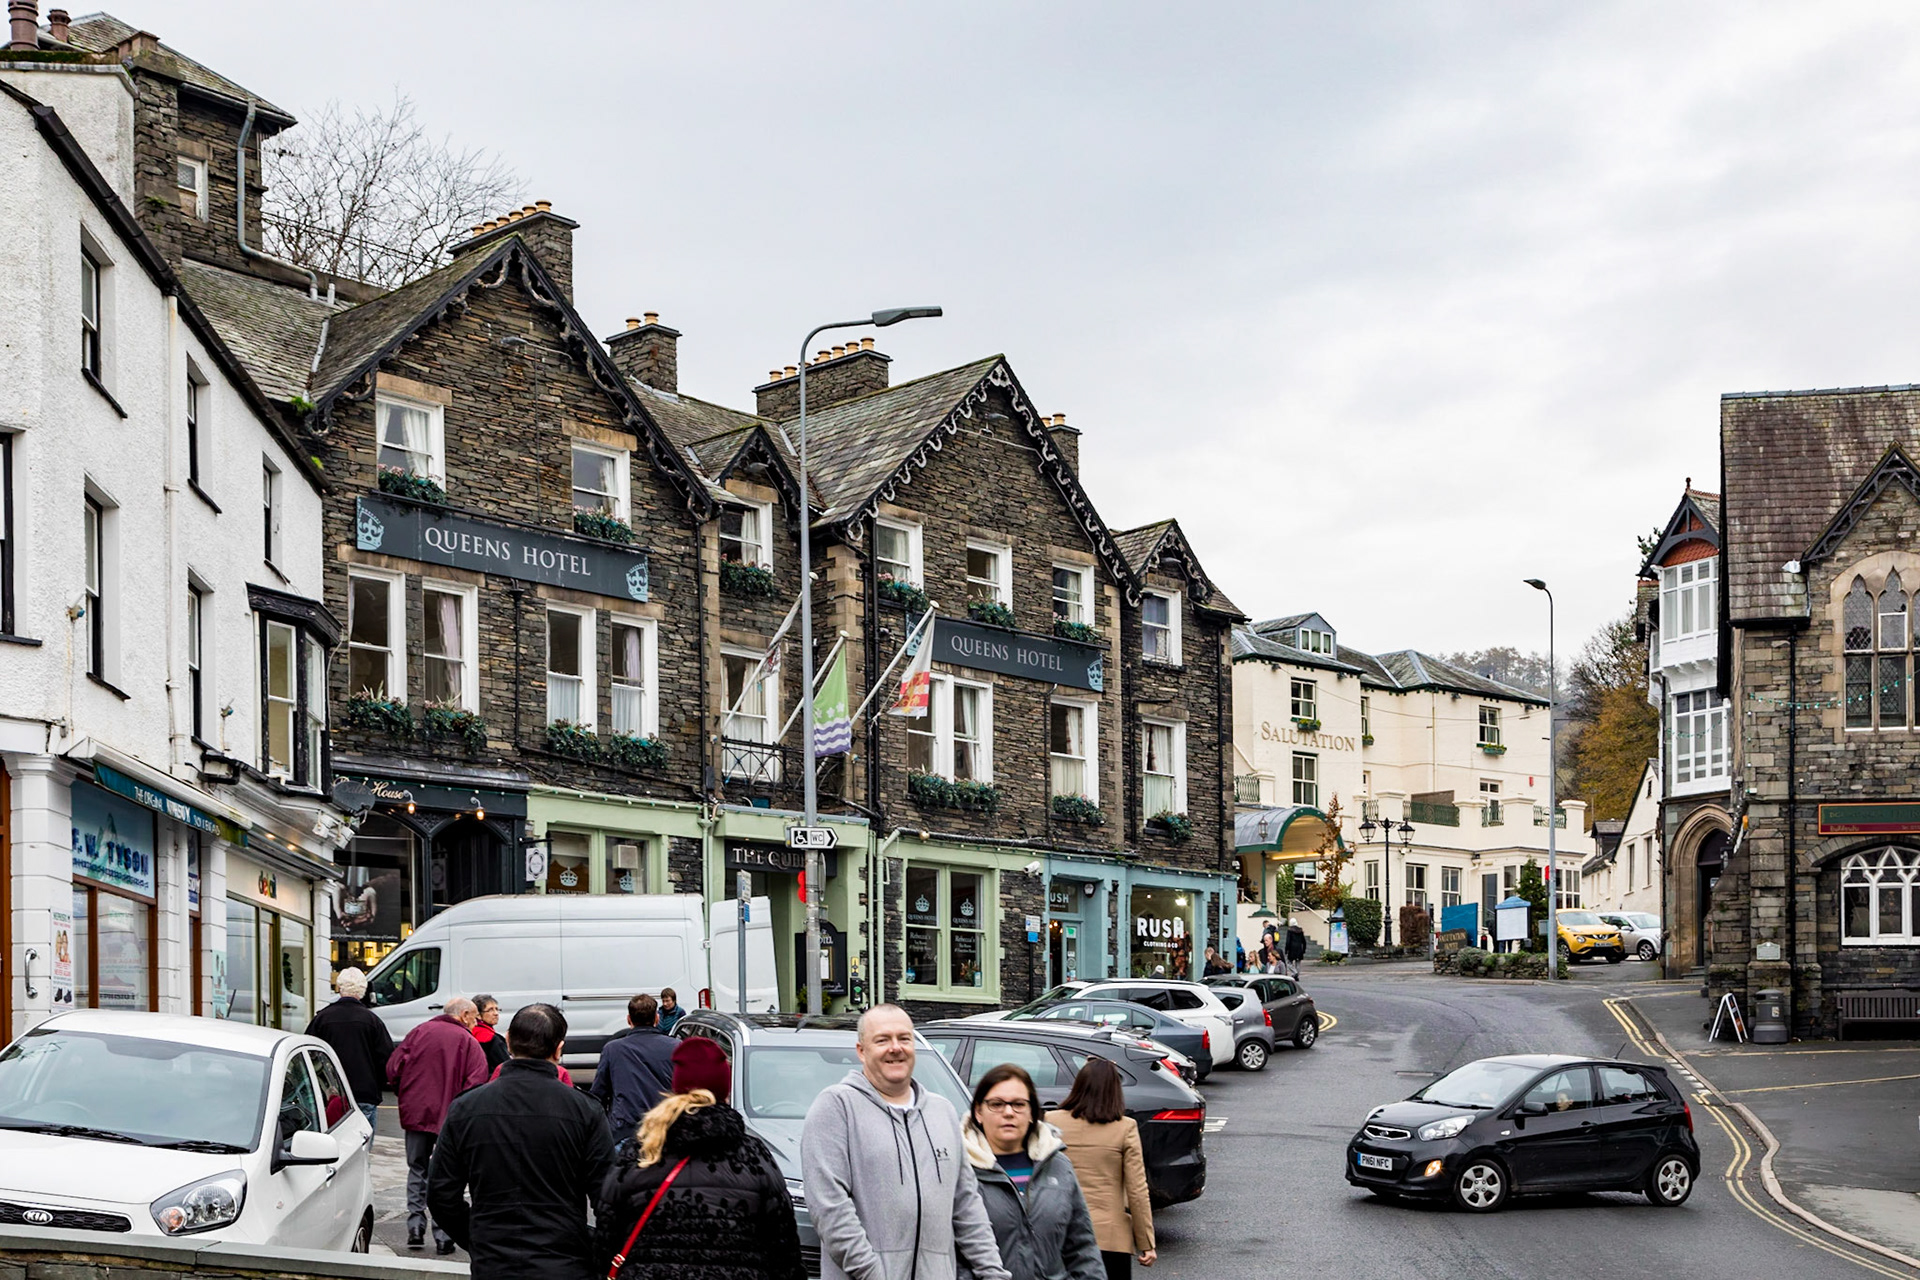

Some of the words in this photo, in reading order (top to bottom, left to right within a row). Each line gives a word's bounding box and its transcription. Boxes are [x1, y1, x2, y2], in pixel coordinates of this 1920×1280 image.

[425, 527, 511, 560] QUEENS
[522, 546, 592, 576] HOTEL
[951, 635, 1010, 661] QUEENS
[1017, 648, 1064, 672] HOTEL
[371, 781, 404, 799] House
[107, 840, 149, 876] TYSON
[732, 848, 765, 865] THE
[1049, 892, 1069, 903] USH
[1136, 916, 1185, 939] RUSH
[1143, 940, 1167, 948] CLOTHING
[1376, 1158, 1389, 1168] NFC
[26, 1211, 48, 1222] KIA
